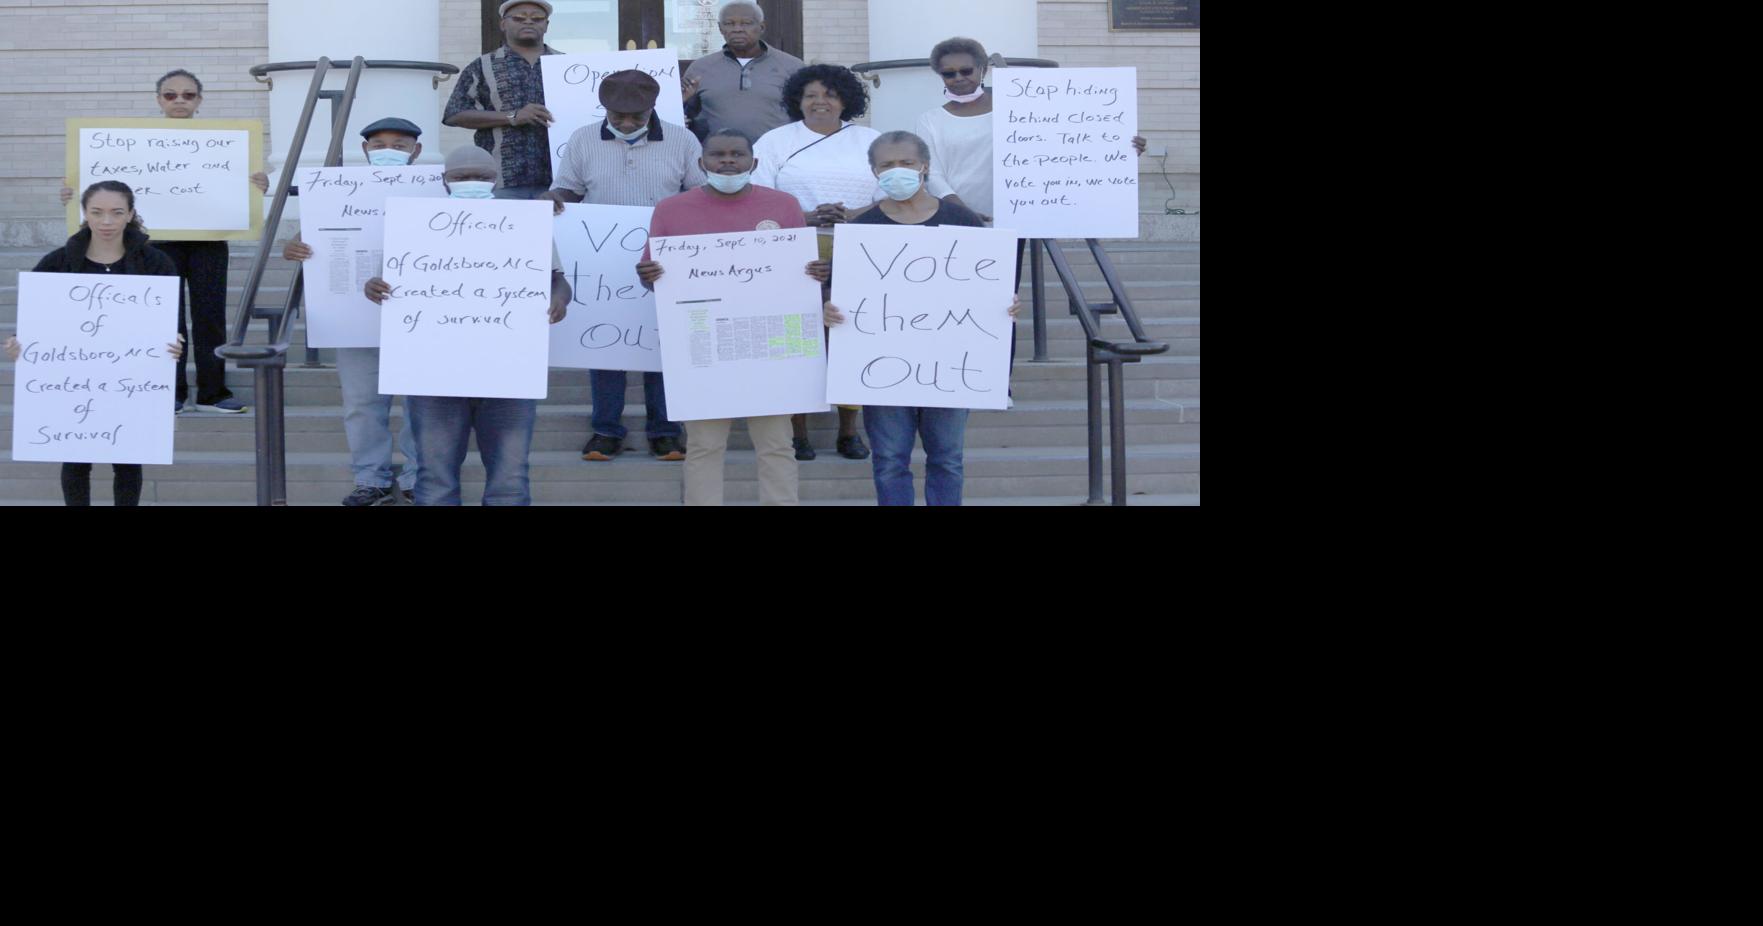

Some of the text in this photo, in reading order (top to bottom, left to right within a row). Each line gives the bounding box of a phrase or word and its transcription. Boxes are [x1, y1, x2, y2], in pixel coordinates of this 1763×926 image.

[1007, 78, 1058, 101] Stop
[90, 133, 136, 152] Stop
[206, 139, 235, 148] our
[1056, 133, 1092, 144] Talk
[1102, 132, 1120, 142] to
[1002, 153, 1029, 167] the
[170, 183, 203, 195] cost
[306, 171, 363, 196] Friday,
[372, 171, 405, 186] Sept
[429, 174, 443, 183] 20
[1043, 180, 1061, 194] you
[341, 204, 379, 217] News
[1010, 195, 1076, 214] you out.
[429, 210, 514, 237] Officials
[580, 219, 649, 254] Vo
[653, 236, 707, 258] Friday,
[715, 237, 746, 250] Sept
[413, 255, 498, 272] Goldsboro,
[860, 240, 1000, 283] Vote
[390, 283, 464, 298] Created
[473, 288, 487, 298] a
[564, 259, 650, 307] the
[69, 283, 161, 310] Officials
[403, 311, 422, 333] of
[580, 322, 659, 352] Ou
[23, 342, 120, 364] Goldsboro,
[26, 376, 91, 393] Created
[98, 382, 107, 391] a
[74, 398, 95, 424] of
[30, 422, 123, 445] Survival
